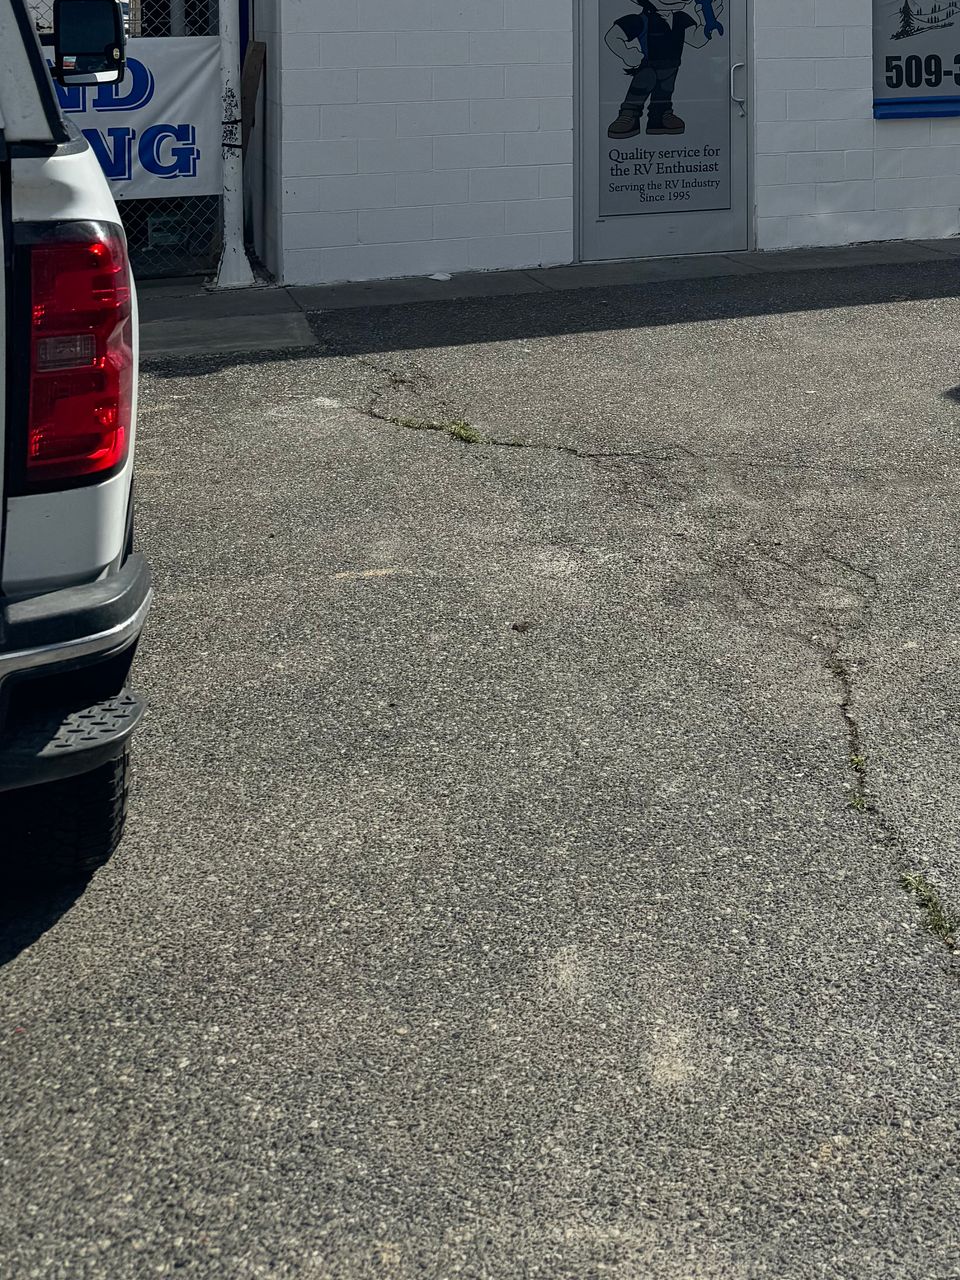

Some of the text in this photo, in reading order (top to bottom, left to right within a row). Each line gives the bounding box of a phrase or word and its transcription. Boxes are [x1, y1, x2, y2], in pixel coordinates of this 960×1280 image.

[608, 145, 721, 163] Quality service for
[610, 161, 719, 176] the RV Enthusiast
[608, 178, 721, 194] Serving the RV Industry
[639, 191, 691, 202] Since 1995
